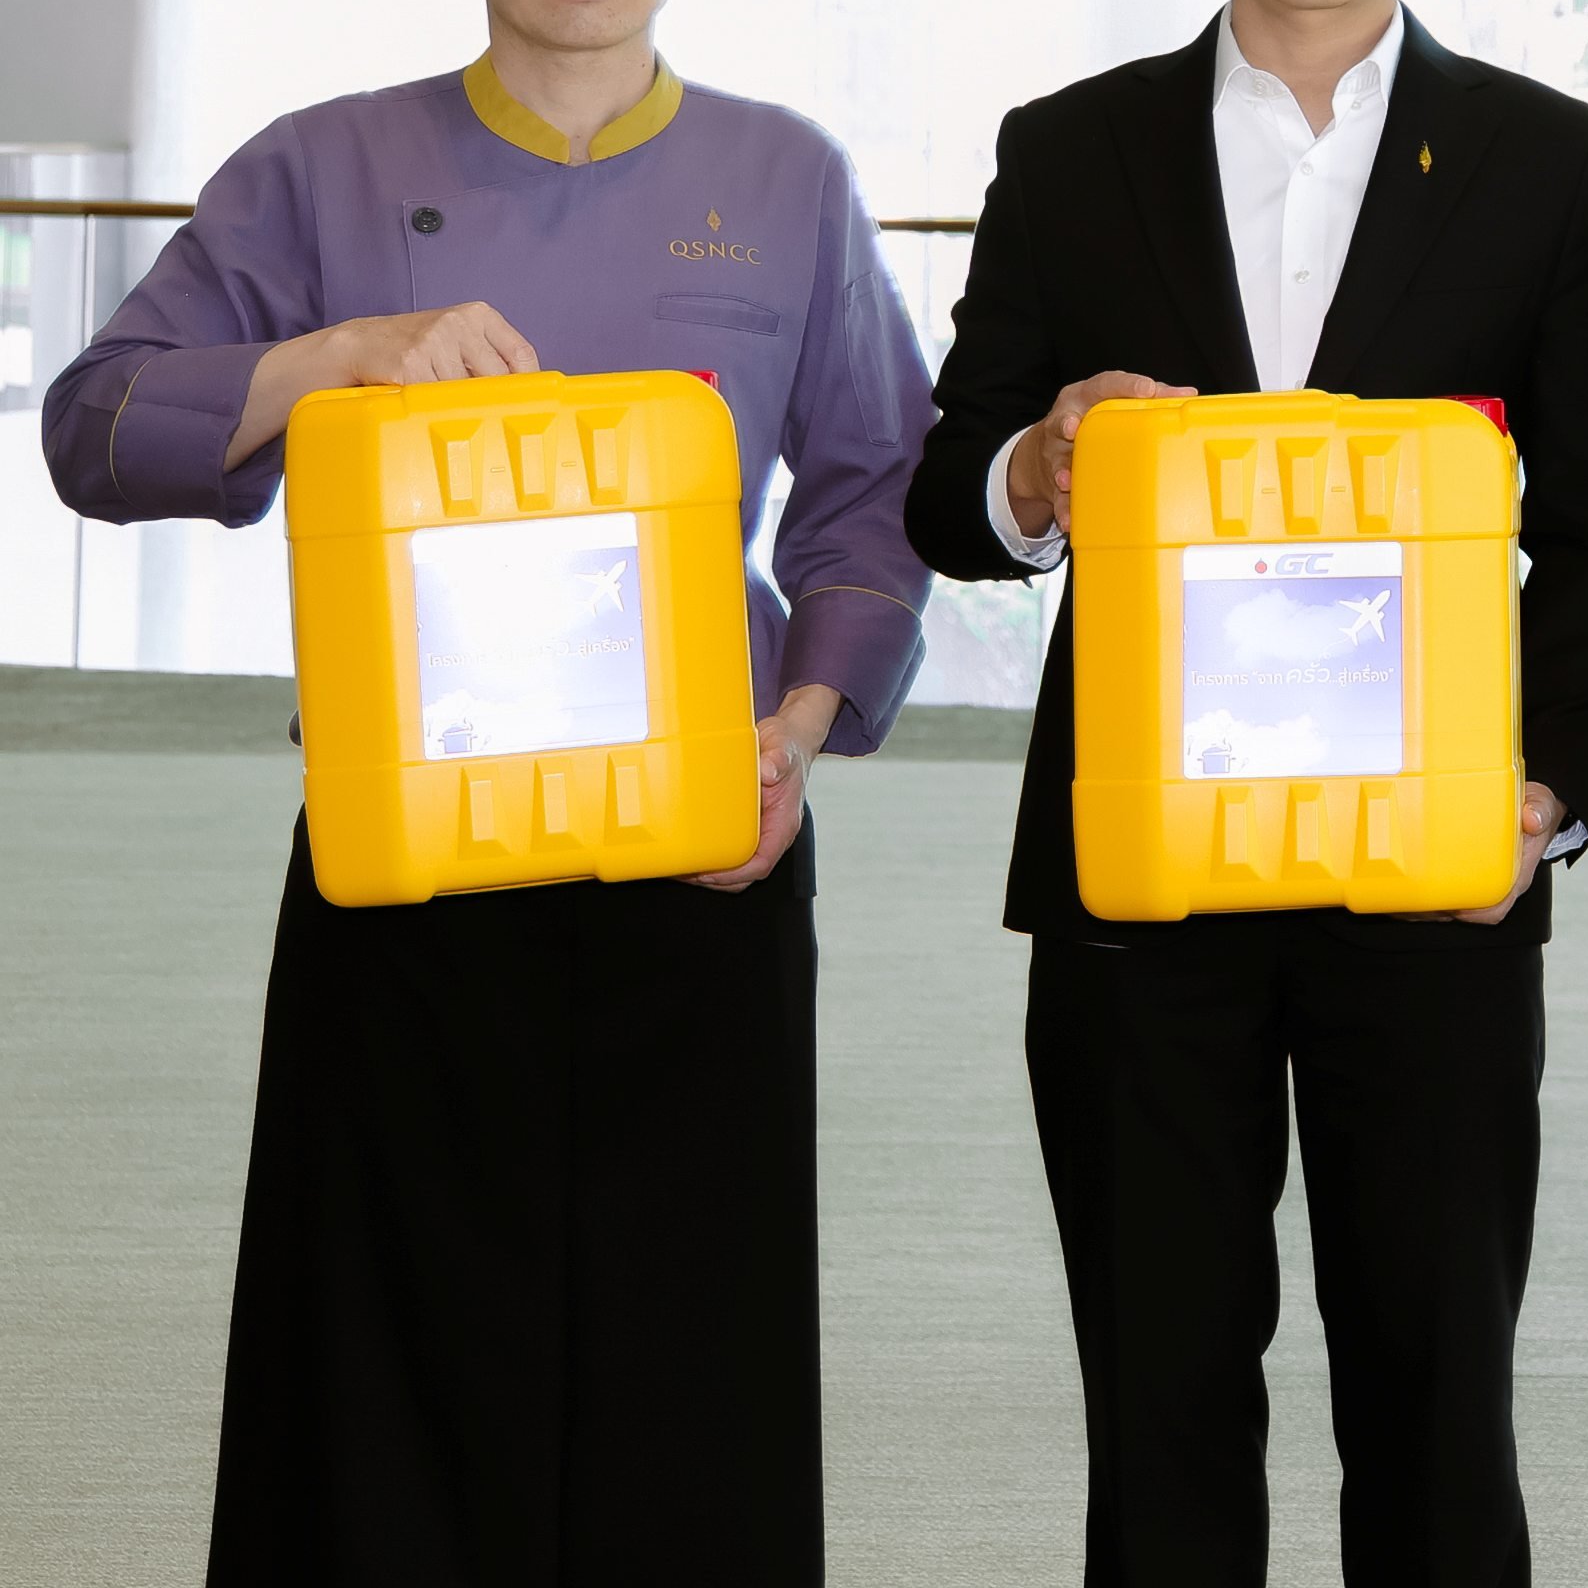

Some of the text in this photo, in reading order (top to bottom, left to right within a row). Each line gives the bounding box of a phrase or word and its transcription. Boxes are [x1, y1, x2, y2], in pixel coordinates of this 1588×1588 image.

[668, 239, 763, 265] QSNCC
[1274, 553, 1334, 576] GC
[1191, 670, 1249, 686] โครงการ
